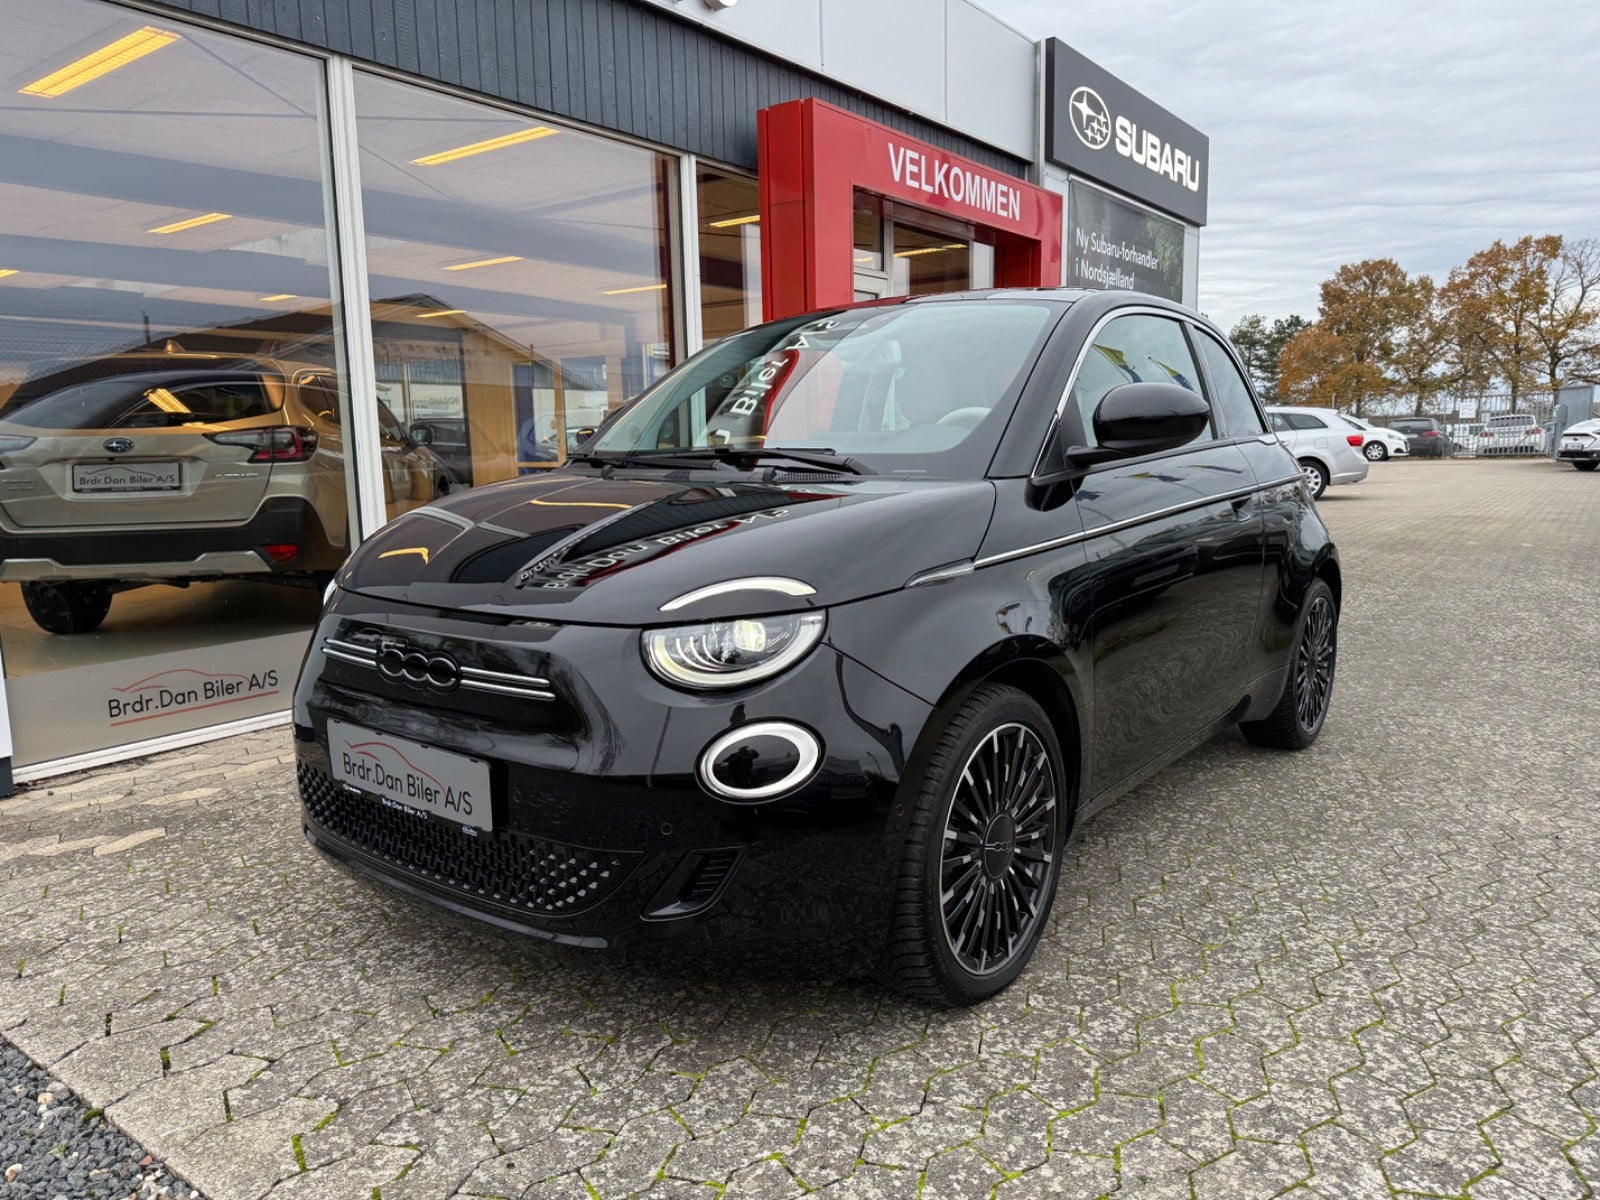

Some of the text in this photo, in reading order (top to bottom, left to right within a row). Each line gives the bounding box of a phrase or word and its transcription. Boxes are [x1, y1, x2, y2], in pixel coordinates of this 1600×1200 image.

[1115, 115, 1200, 192] SUBARU
[888, 142, 1021, 221] VELKOMMEN
[1075, 257, 1135, 289] i Nordsjælland
[1076, 227, 1159, 270] Ny Subaru-forhandler
[79, 474, 176, 486] Brdr.Dan Biler A/S
[108, 669, 279, 718] Brdr.Dan Biler A/S
[343, 752, 473, 816] Brdr.Dan Biler A/S
